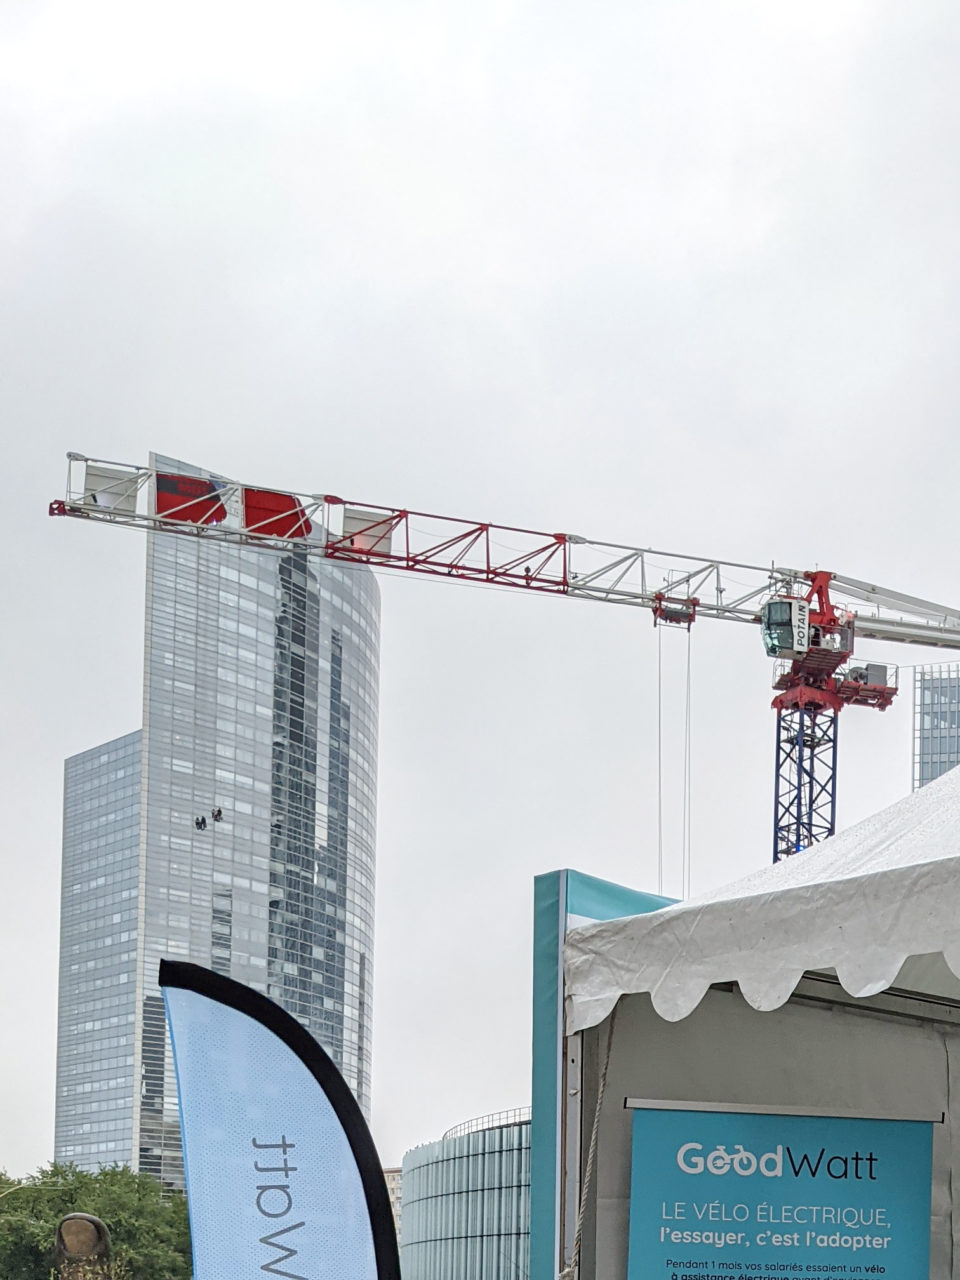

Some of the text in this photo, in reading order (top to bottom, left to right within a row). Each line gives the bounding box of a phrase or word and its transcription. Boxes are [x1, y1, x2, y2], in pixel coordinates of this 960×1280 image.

[797, 604, 807, 647] POTAIN
[676, 1142, 878, 1180] GoodWatt
[662, 1200, 891, 1229] LE VÉLO ÉLECTRIQUE,
[660, 1226, 892, 1251] l'essayer, c'est l'adopter
[666, 1259, 886, 1274] Pendant 1 mois vos salariés essaient un vélo
[671, 1272, 678, 1280] à
